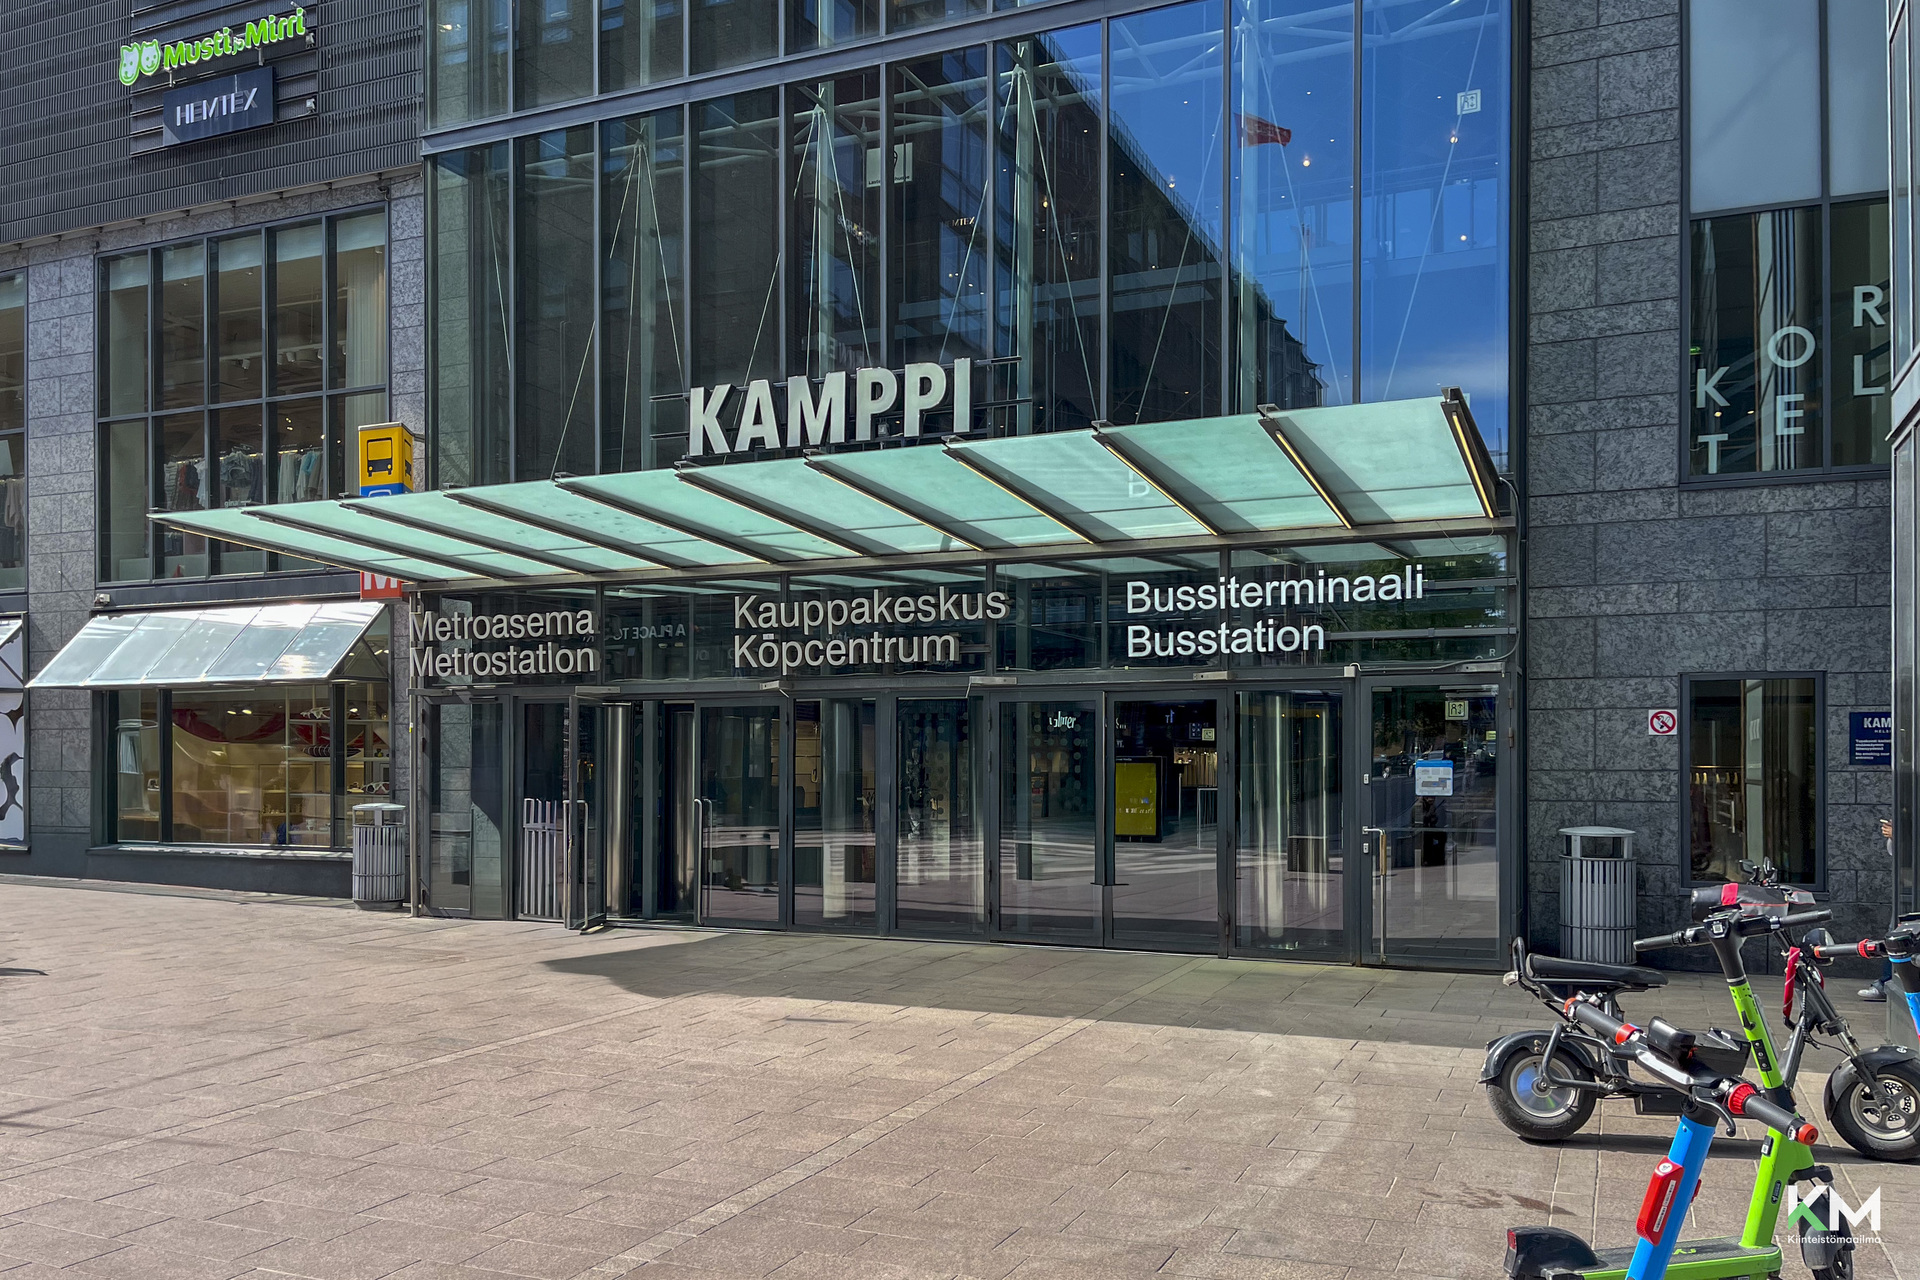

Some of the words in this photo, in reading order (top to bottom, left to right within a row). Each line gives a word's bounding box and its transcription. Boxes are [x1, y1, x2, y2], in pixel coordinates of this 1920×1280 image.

[163, 27, 232, 69] Musti
[245, 8, 306, 49] Mirri
[176, 87, 258, 127] HEMTEX
[689, 357, 972, 456] KAMPPI
[734, 586, 1008, 635] Kauppakeskus
[1126, 564, 1423, 614] Bussiterminaali
[409, 610, 595, 642] Metroasema
[1127, 618, 1325, 658] Busstation
[409, 641, 595, 677] Metrostation
